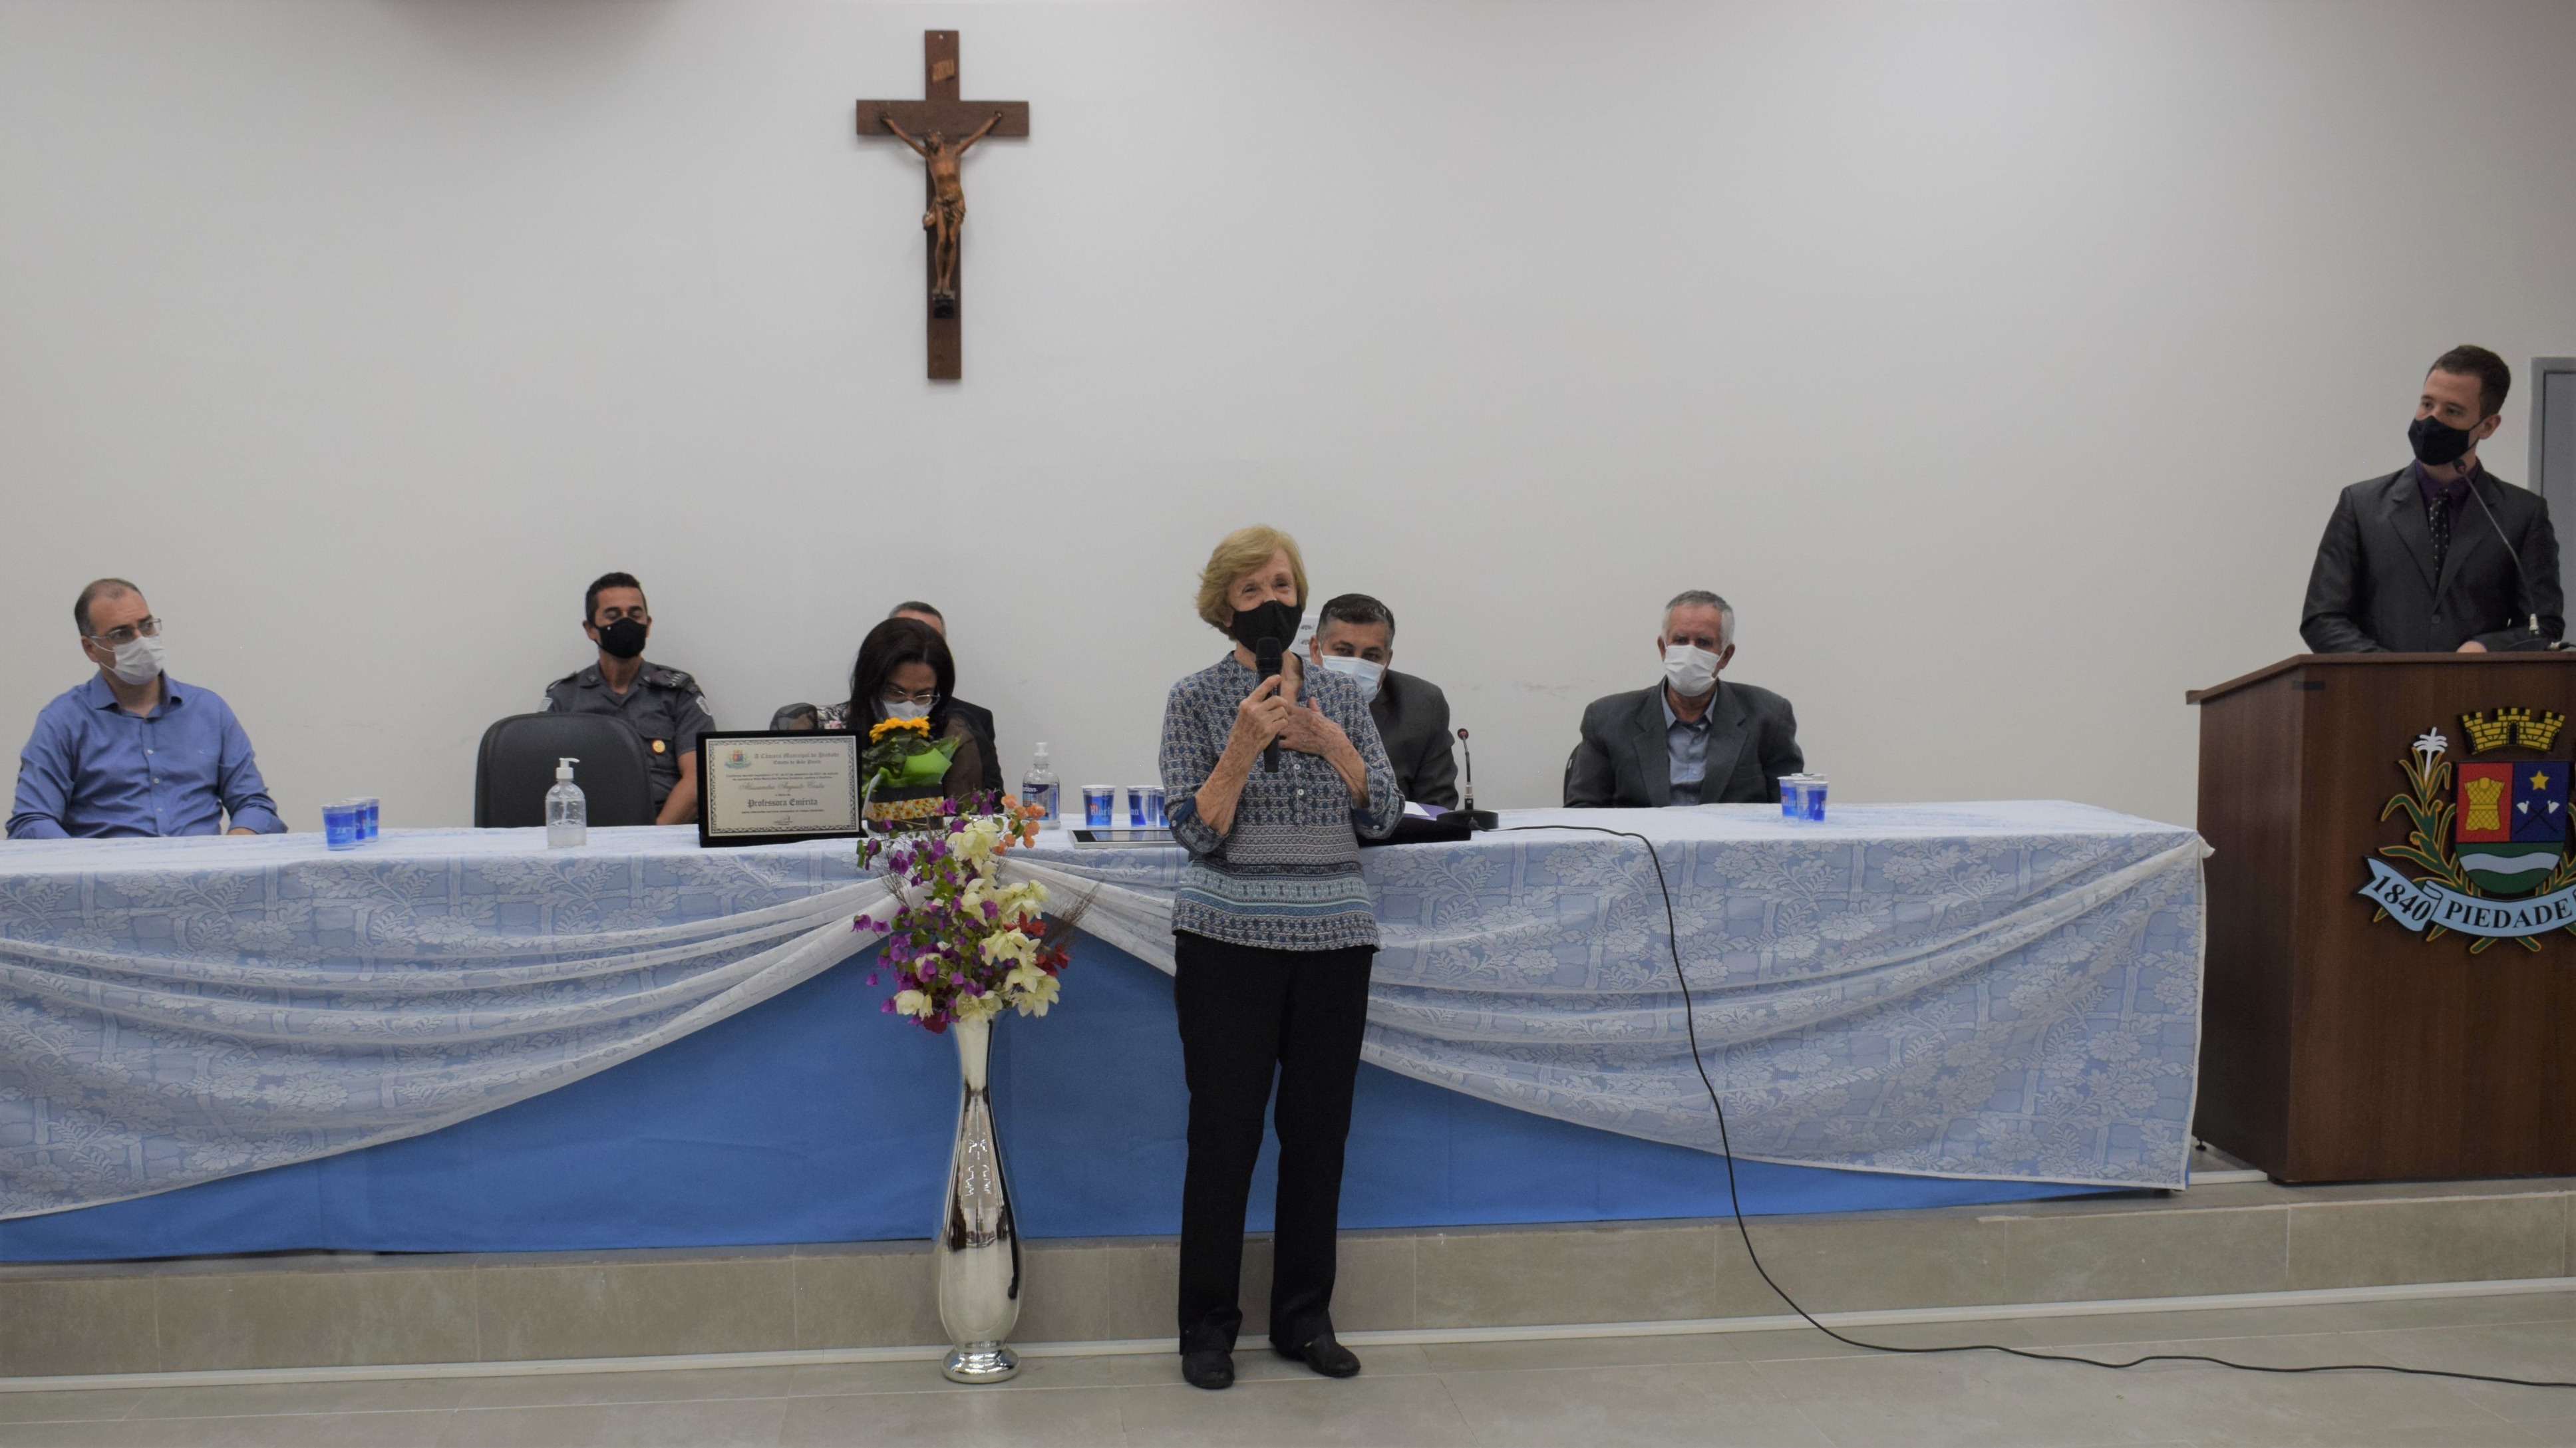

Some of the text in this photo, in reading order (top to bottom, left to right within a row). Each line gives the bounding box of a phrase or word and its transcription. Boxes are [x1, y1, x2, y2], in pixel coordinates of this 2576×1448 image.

[748, 799, 787, 808] Professora
[2371, 875, 2573, 929] 1840 PIEDADE
